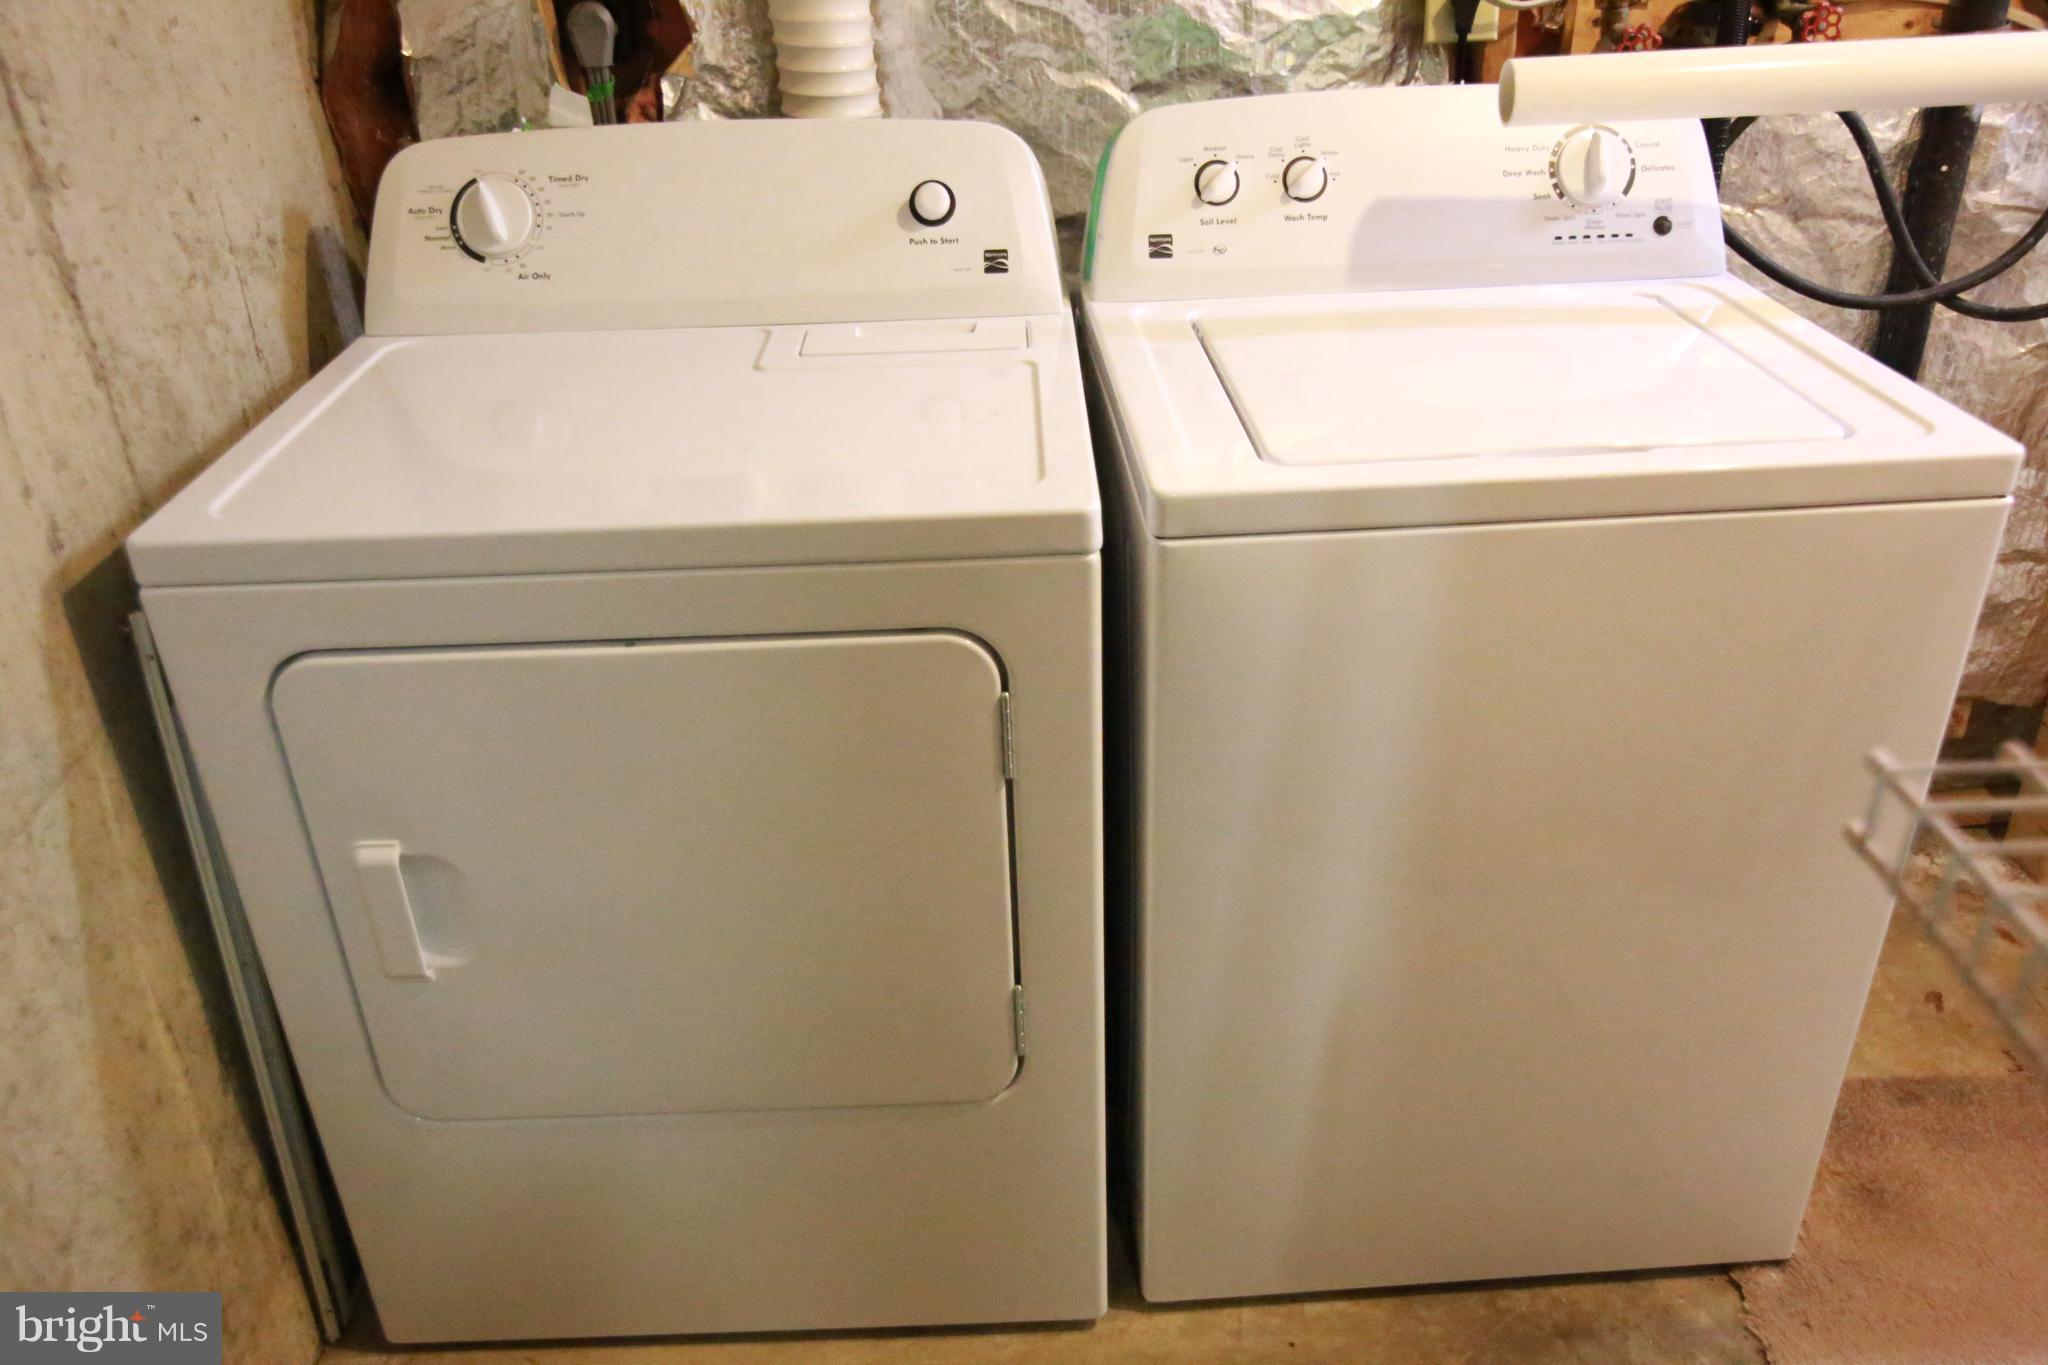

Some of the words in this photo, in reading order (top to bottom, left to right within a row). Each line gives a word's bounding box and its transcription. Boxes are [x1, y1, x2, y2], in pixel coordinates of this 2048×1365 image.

[548, 175, 573, 183] Timed
[575, 174, 589, 182] Dry
[408, 207, 426, 215] Auto
[429, 207, 443, 215] Dry
[1200, 218, 1214, 226] Soil
[1216, 217, 1237, 225] Level
[1307, 213, 1328, 222] Temp
[940, 237, 959, 245] Start
[532, 272, 551, 280] Only
